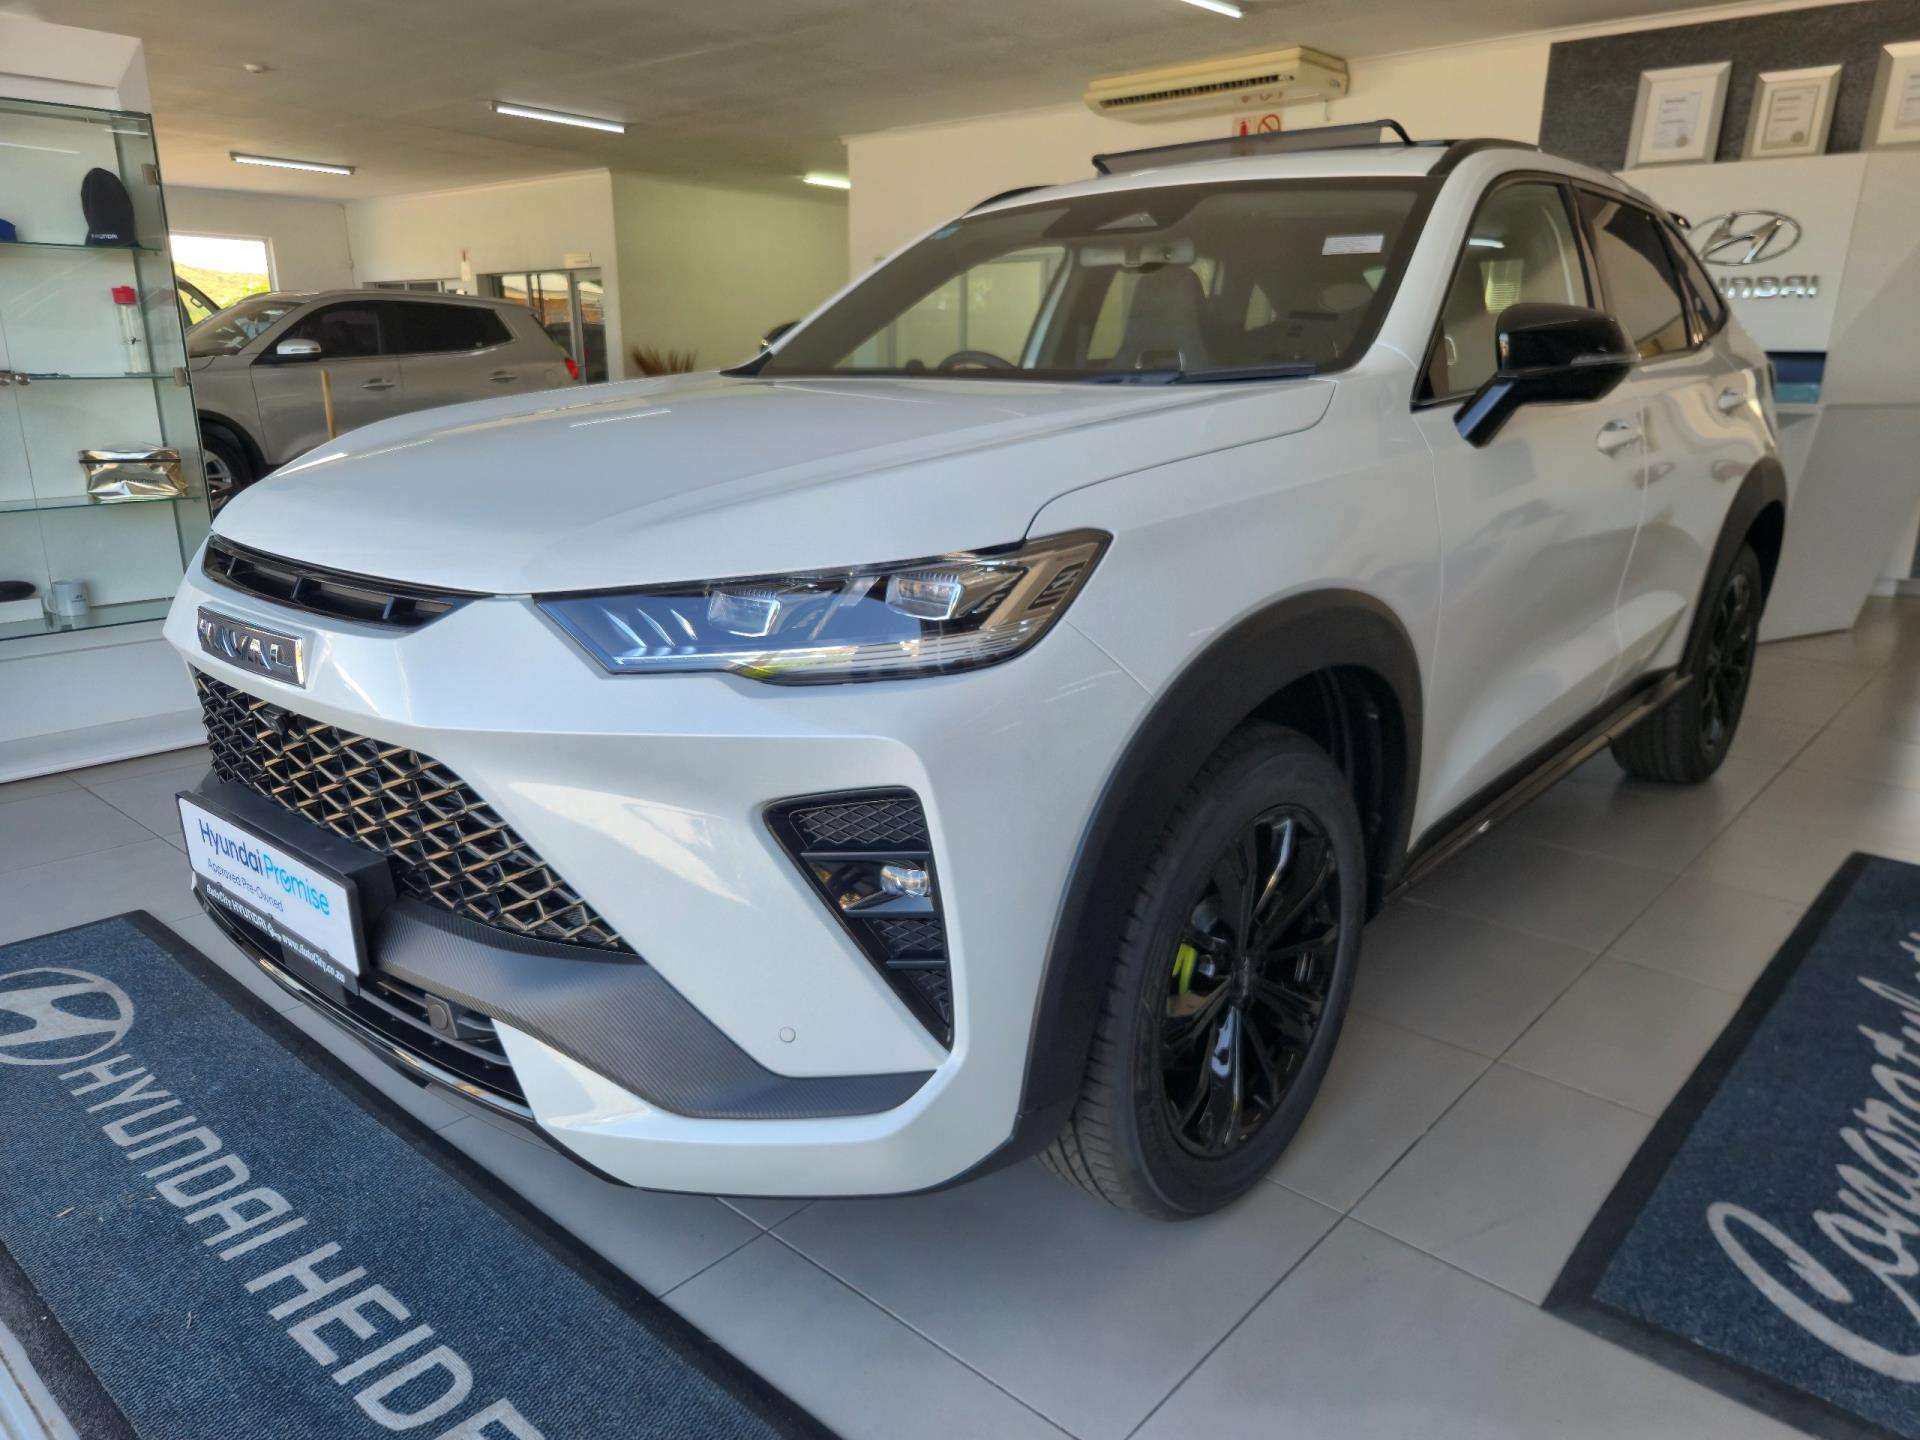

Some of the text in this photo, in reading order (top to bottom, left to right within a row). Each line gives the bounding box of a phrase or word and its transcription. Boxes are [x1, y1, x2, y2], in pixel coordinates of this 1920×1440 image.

[1718, 275, 1819, 299] NDAI
[198, 817, 331, 917] Hyundai Promise
[58, 1053, 308, 1262] HYUNDAI
